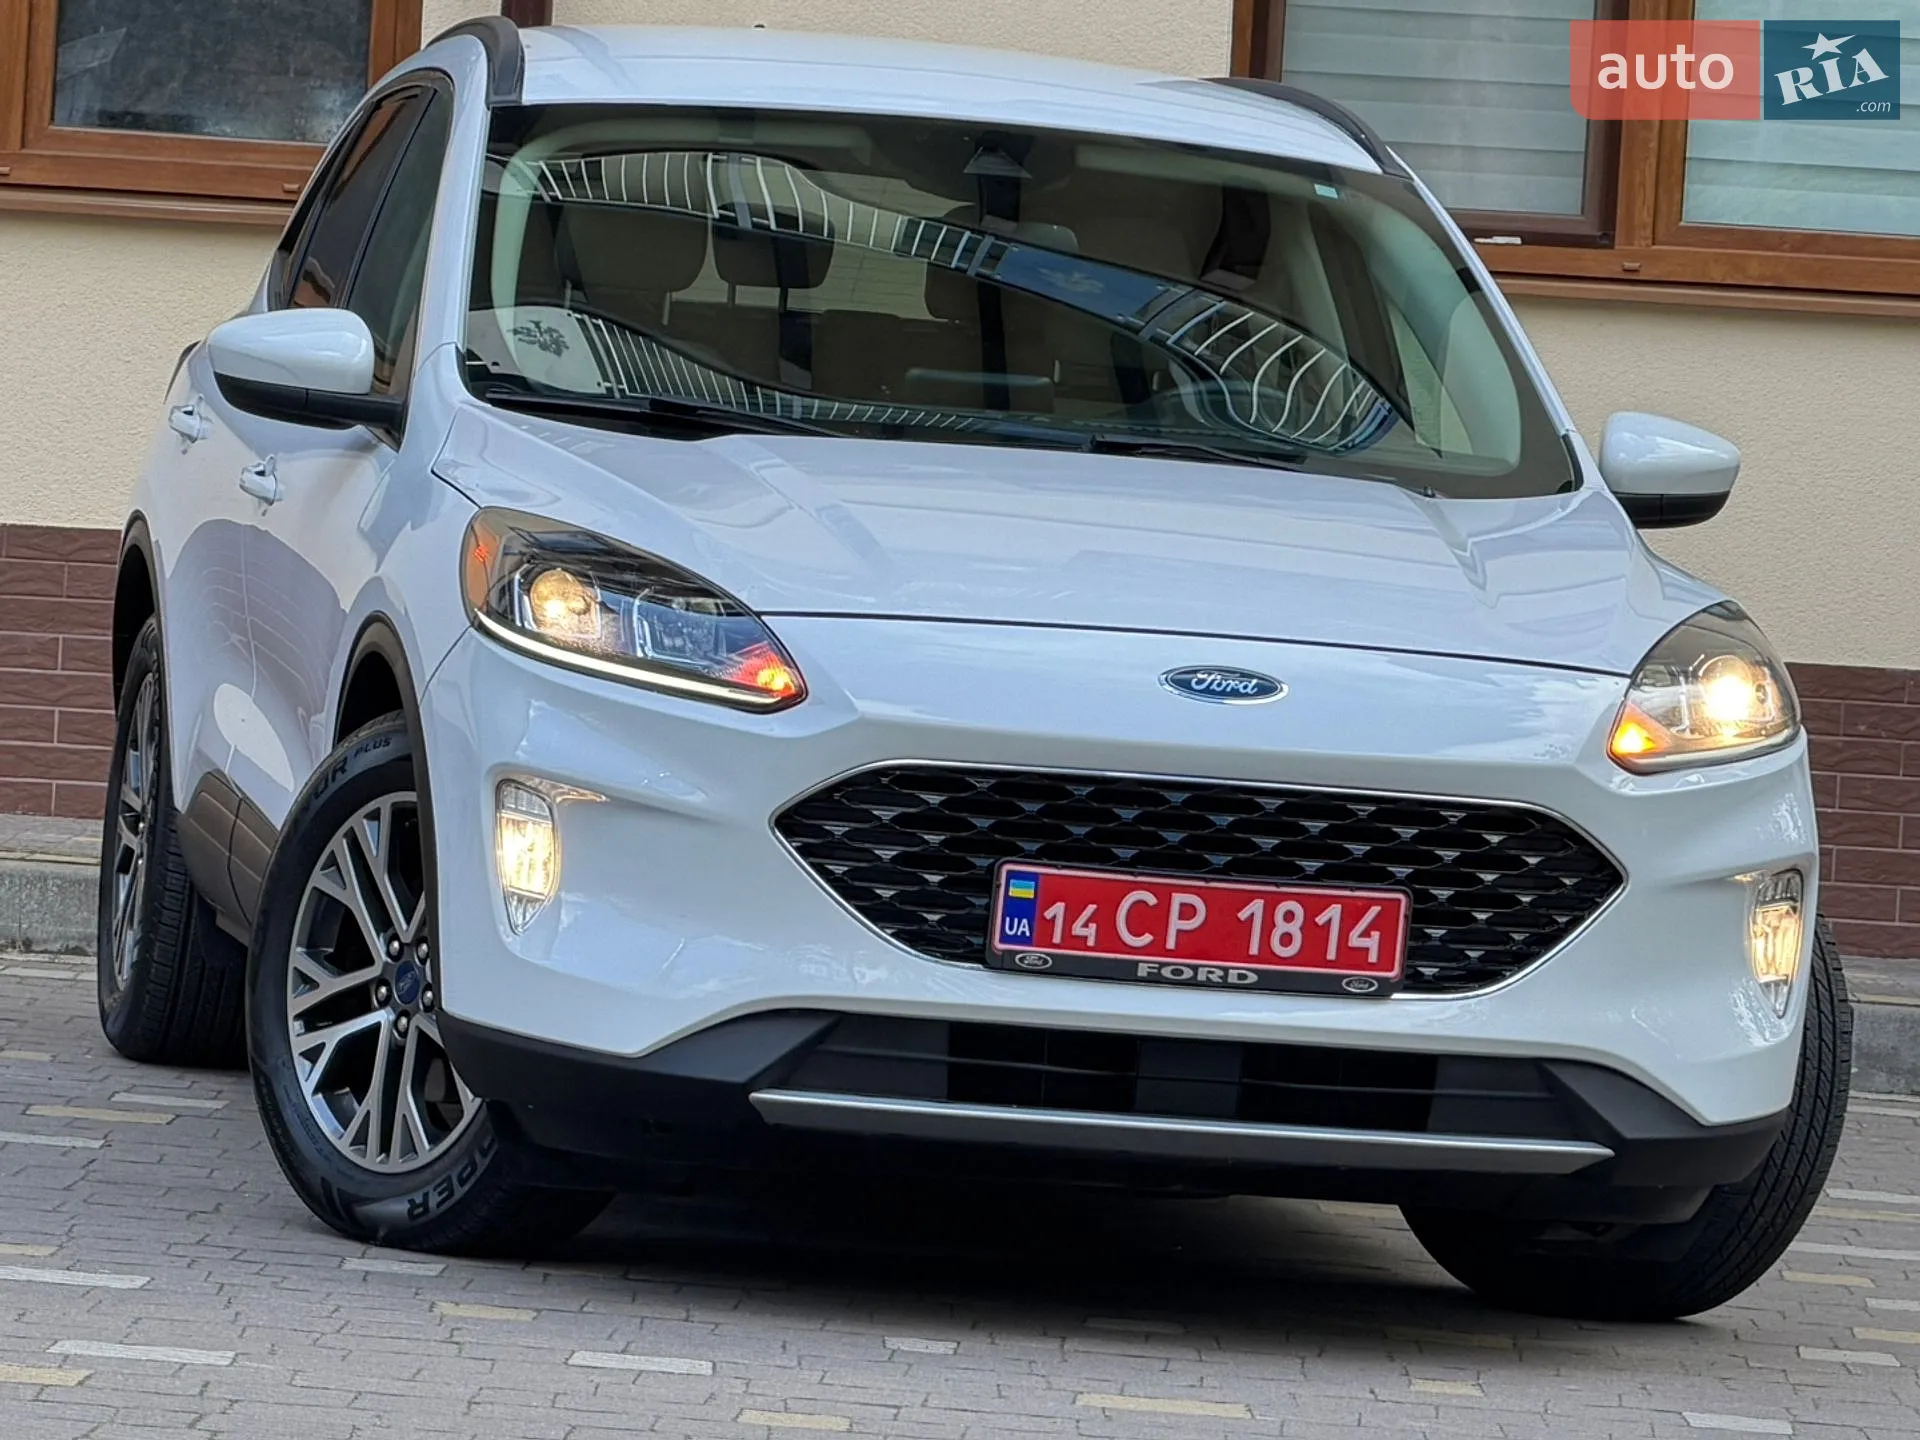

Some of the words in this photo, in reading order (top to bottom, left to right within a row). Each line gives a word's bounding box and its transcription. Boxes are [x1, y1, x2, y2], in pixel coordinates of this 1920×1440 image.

[1191, 670, 1259, 695] Ford
[1005, 916, 1031, 937] UA
[1043, 901, 1099, 947] 14
[1115, 890, 1207, 951] CP
[1237, 898, 1382, 964] 1814
[1137, 962, 1259, 985] FORD
